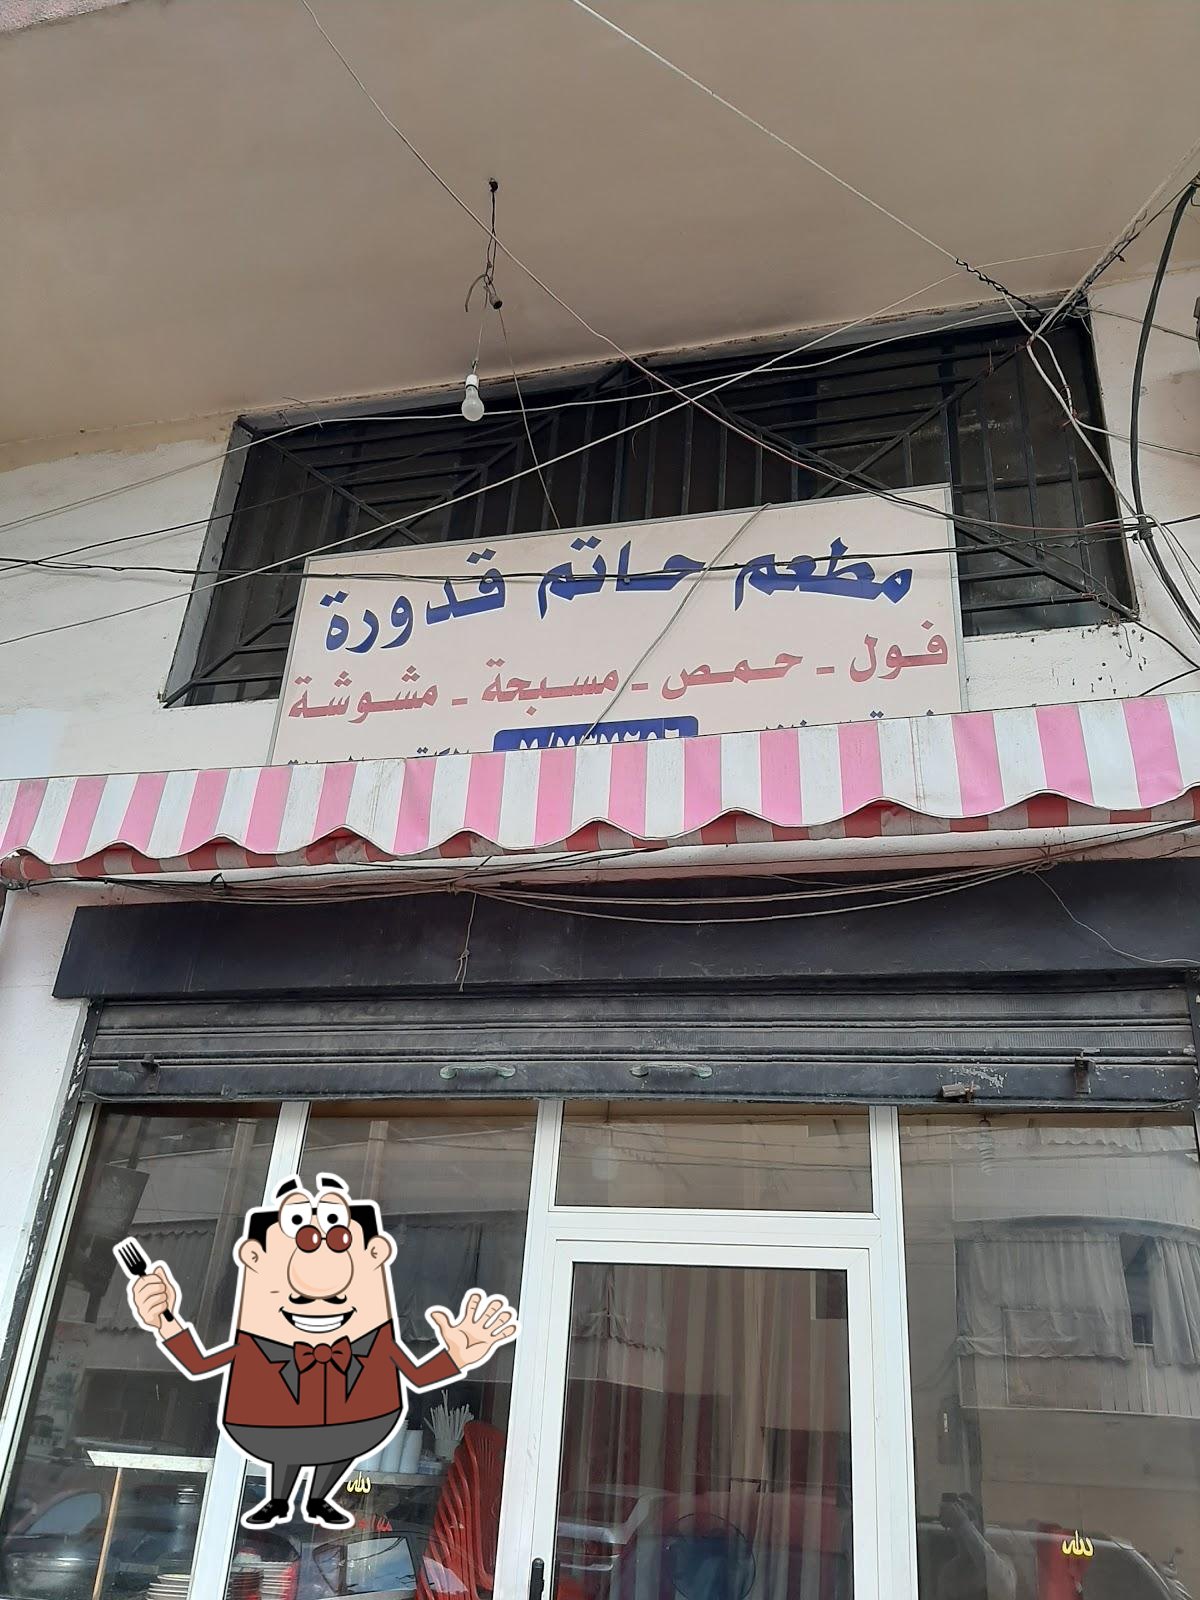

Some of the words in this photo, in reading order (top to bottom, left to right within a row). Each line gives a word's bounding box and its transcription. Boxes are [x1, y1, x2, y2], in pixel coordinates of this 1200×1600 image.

[319, 548, 506, 654] قدورة
[537, 536, 706, 619] حاتم
[735, 537, 912, 611] مطعم
[661, 653, 803, 700] حمص
[848, 620, 948, 683] فول
[288, 665, 438, 723] مشوشة
[481, 659, 619, 716] مسبحة
